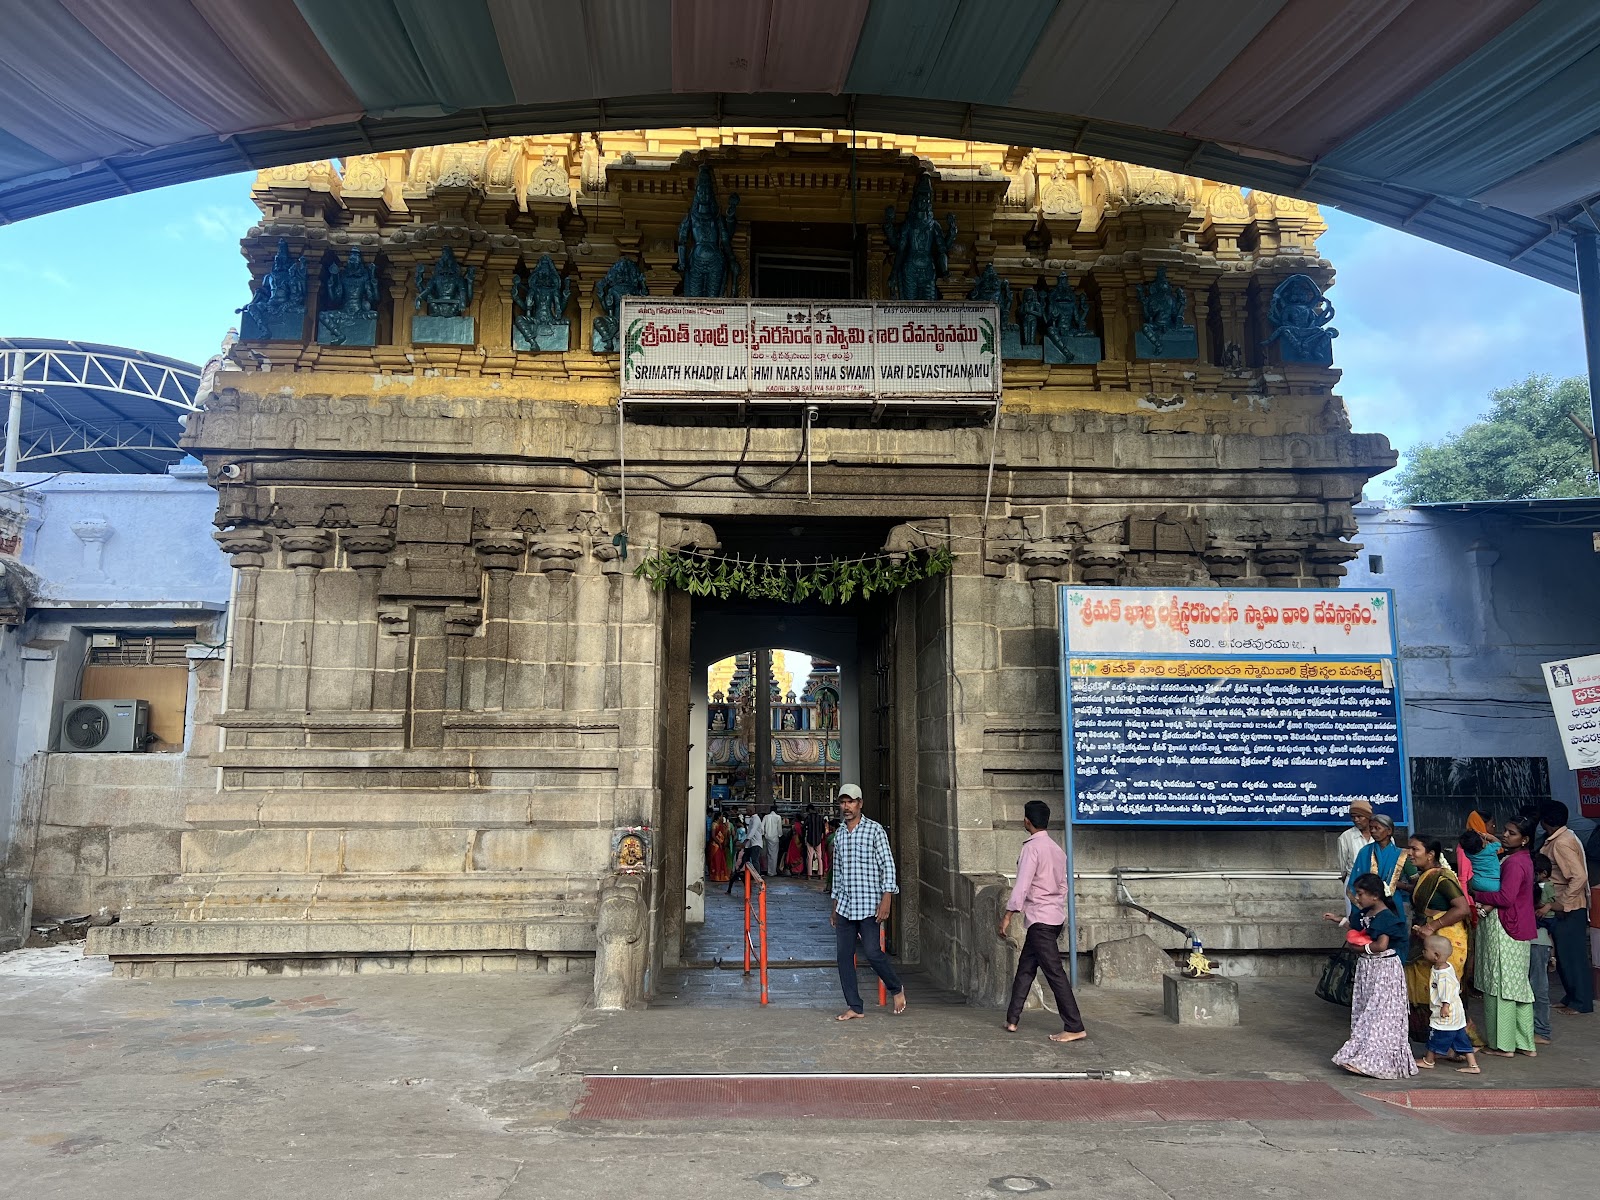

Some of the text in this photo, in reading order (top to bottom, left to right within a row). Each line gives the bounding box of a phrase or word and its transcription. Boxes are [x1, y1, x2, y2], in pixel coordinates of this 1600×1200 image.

[641, 322, 690, 346] శ్రీమత్
[826, 324, 864, 350] స్వామి
[902, 321, 978, 353] దేవస్థానము
[635, 365, 681, 380] SRIMATH
[684, 365, 724, 380] KHADRI
[776, 365, 837, 381] NARASMHA
[880, 365, 904, 380] VARI
[907, 364, 990, 379] DEVASTHANAMU
[1079, 597, 1121, 628] శ్రీమత్
[1244, 604, 1279, 631] స్వామి
[1282, 605, 1310, 625] వారి
